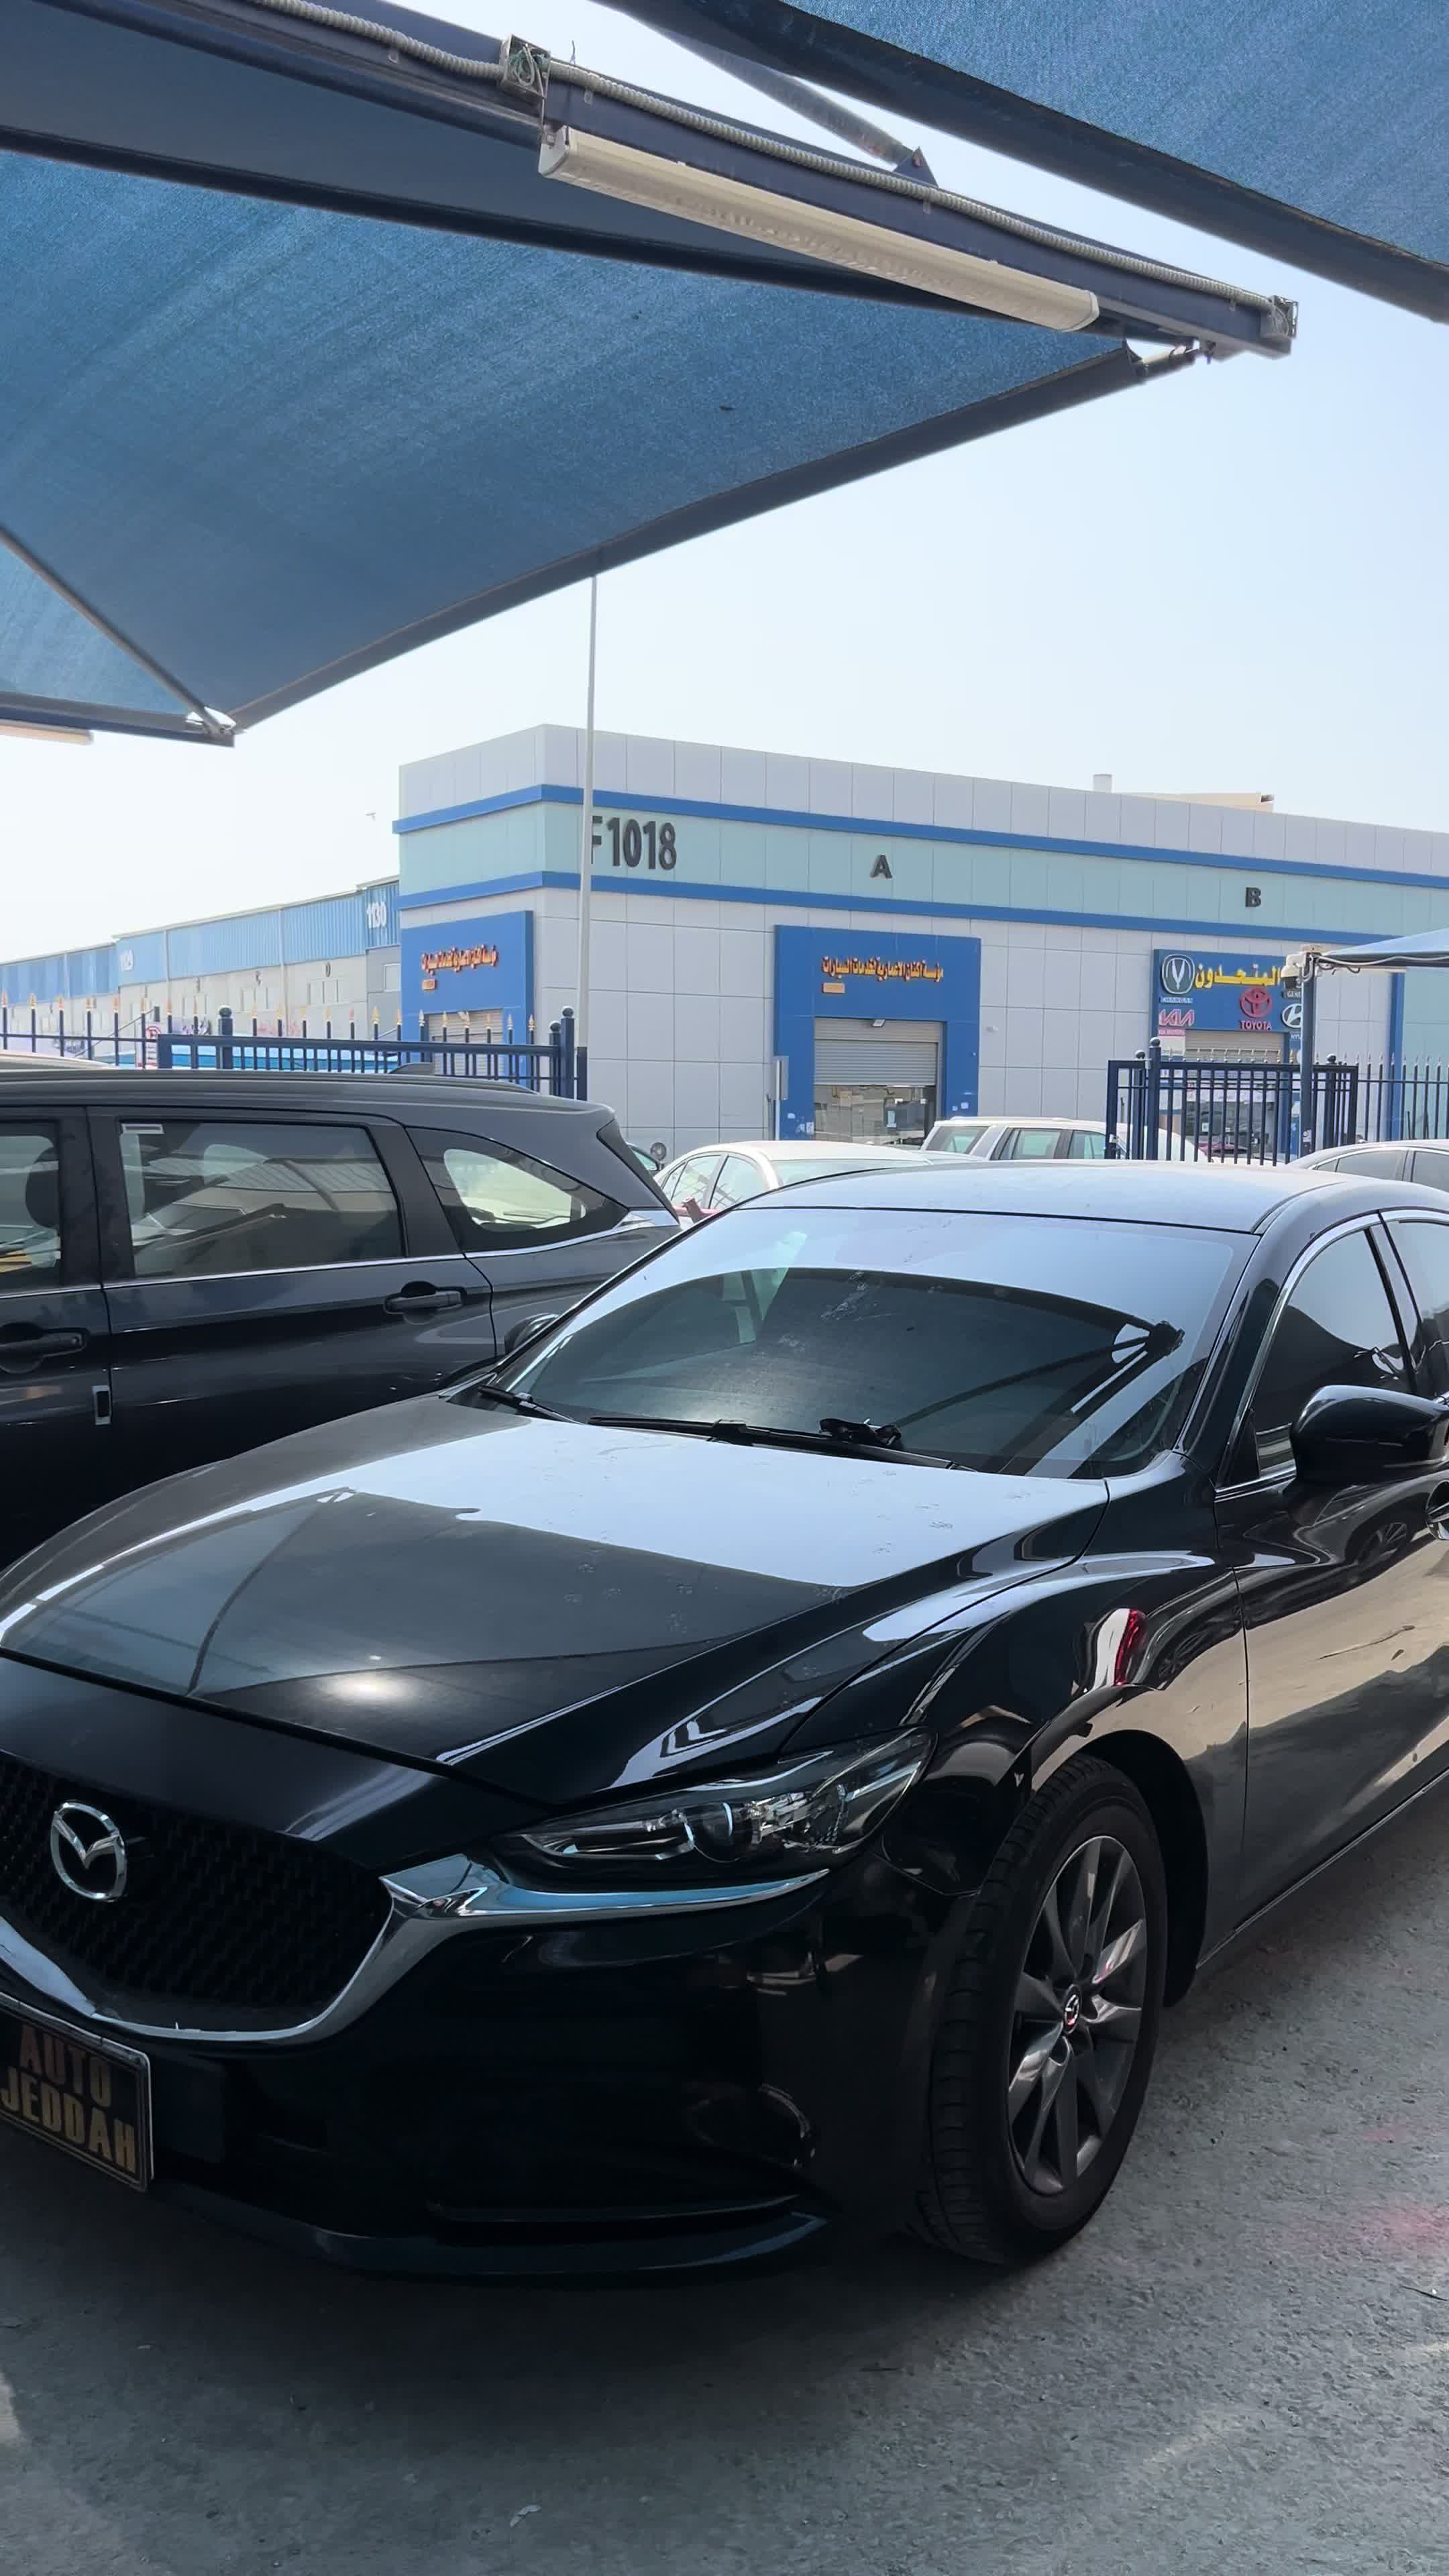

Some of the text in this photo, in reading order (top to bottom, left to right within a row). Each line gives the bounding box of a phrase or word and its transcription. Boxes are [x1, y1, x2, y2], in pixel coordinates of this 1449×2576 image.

[591, 816, 677, 871] F1018
[869, 854, 892, 879] A
[1244, 887, 1262, 908] B
[1241, 1020, 1272, 1031] TOYOTA
[19, 2023, 111, 2107] AUTO
[0, 2066, 136, 2174] JEDDAH
